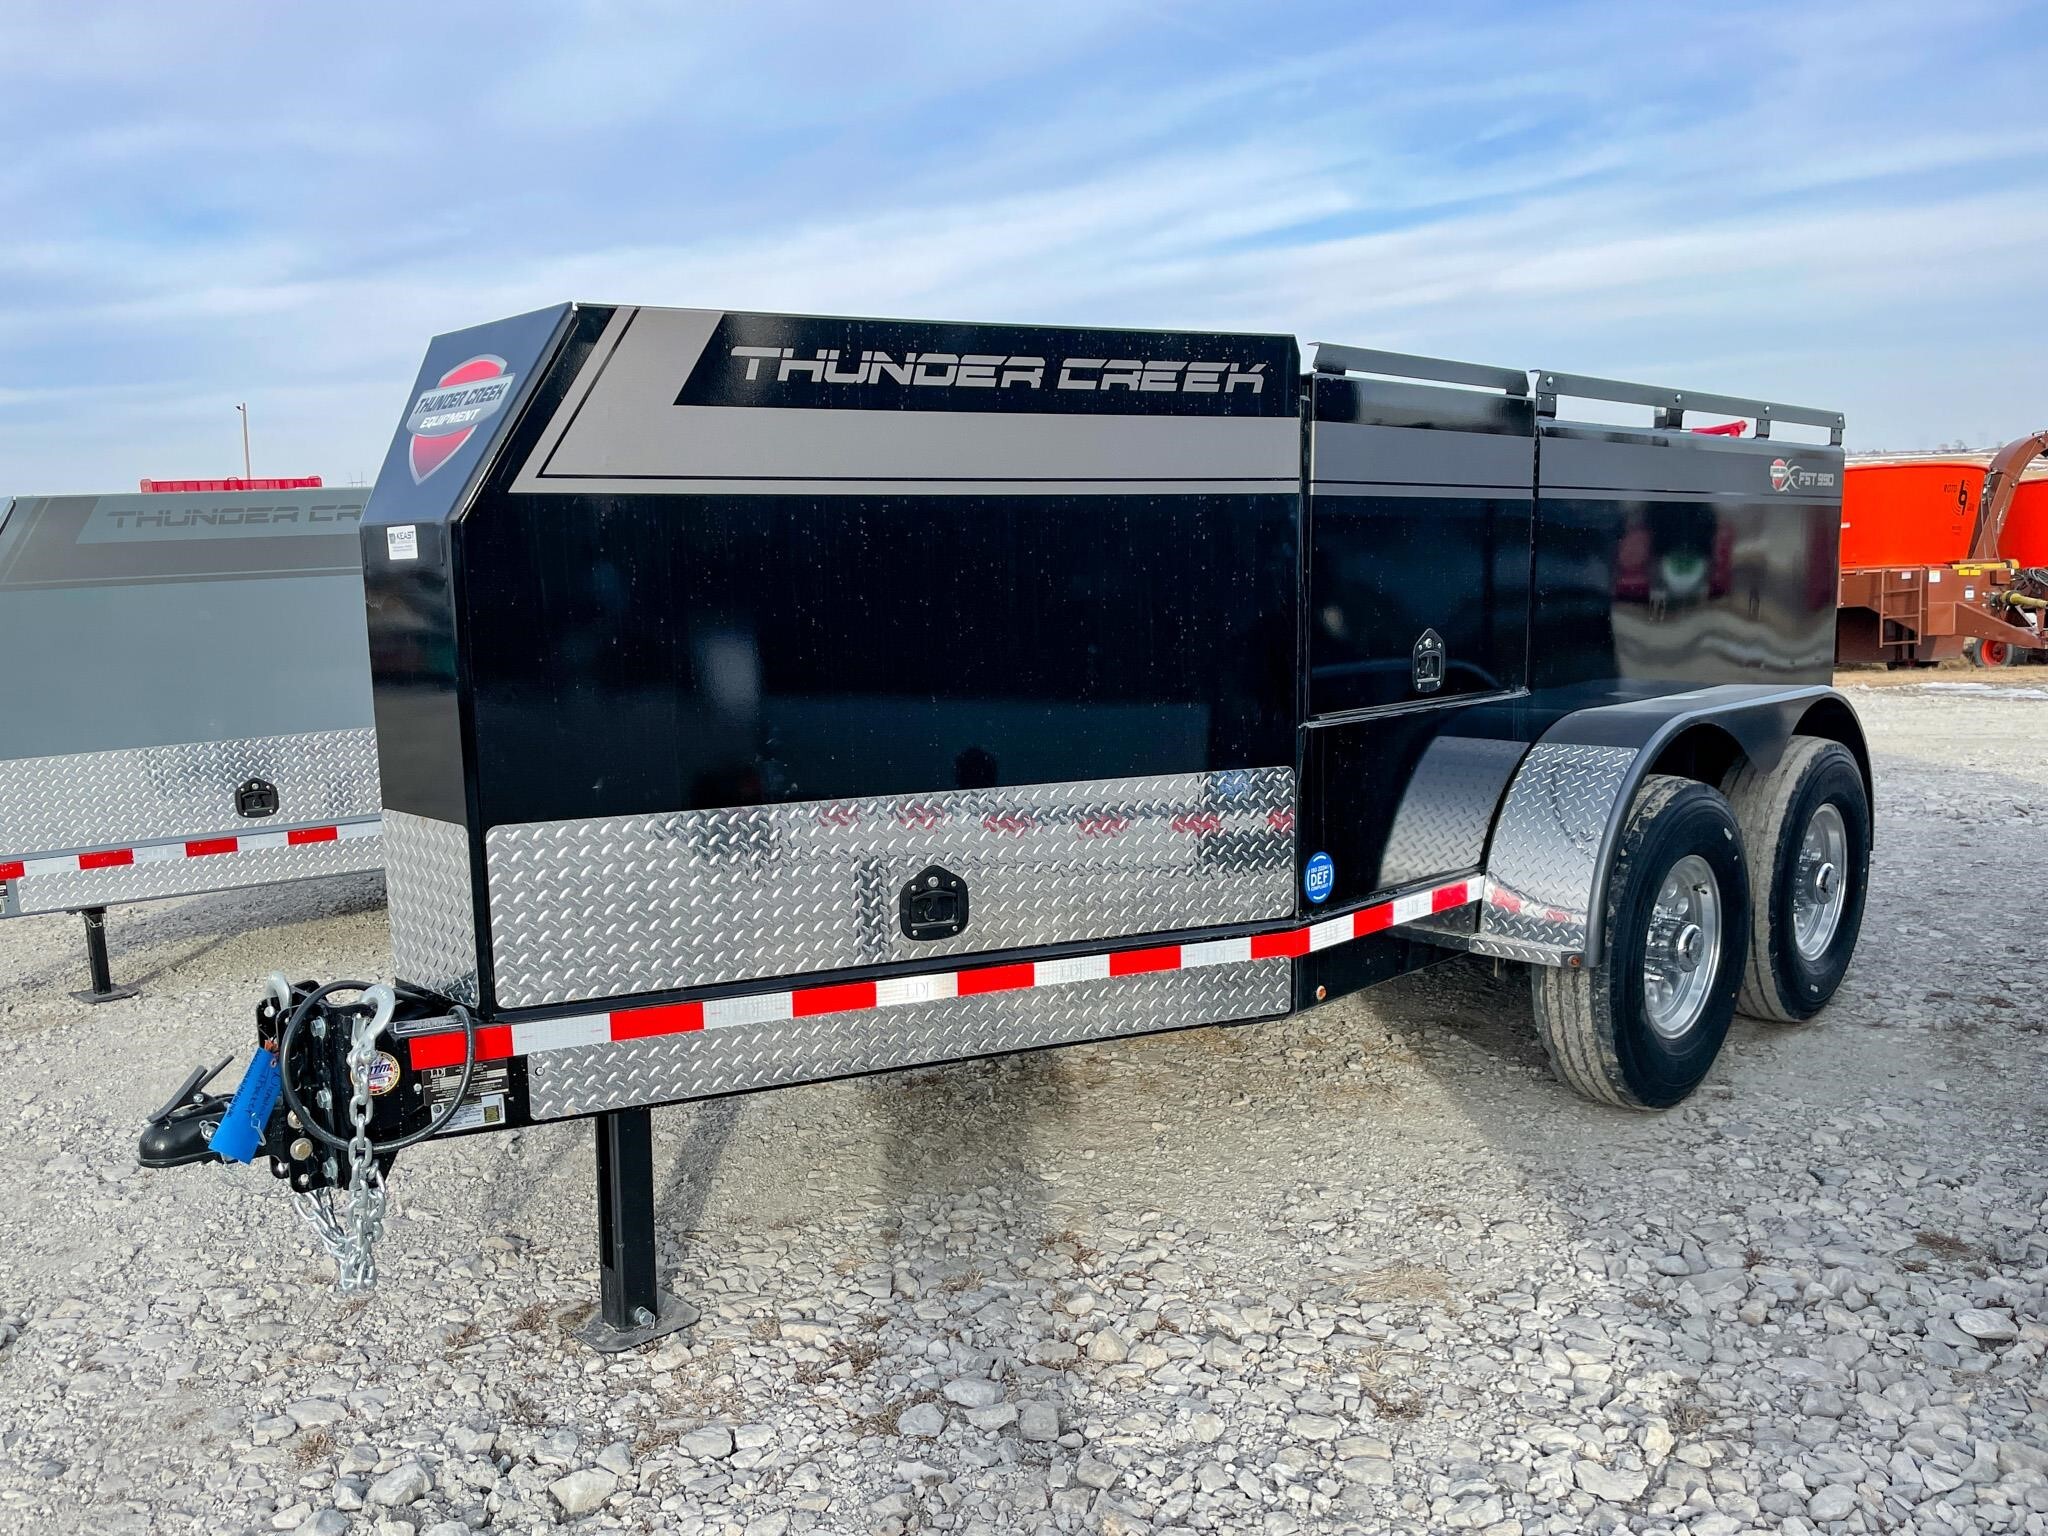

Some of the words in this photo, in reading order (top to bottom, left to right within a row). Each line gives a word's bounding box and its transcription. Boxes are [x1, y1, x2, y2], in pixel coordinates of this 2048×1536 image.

[731, 346, 1045, 388] THUNDER
[1057, 359, 1267, 393] CREEK
[415, 391, 465, 414] THUNDER
[464, 383, 508, 405] CREEK
[420, 409, 481, 428] EQUIPMENT
[1799, 472, 1817, 486] FST
[108, 506, 299, 528] THUNDER
[309, 505, 361, 522] CR
[1310, 870, 1329, 888] DEF
